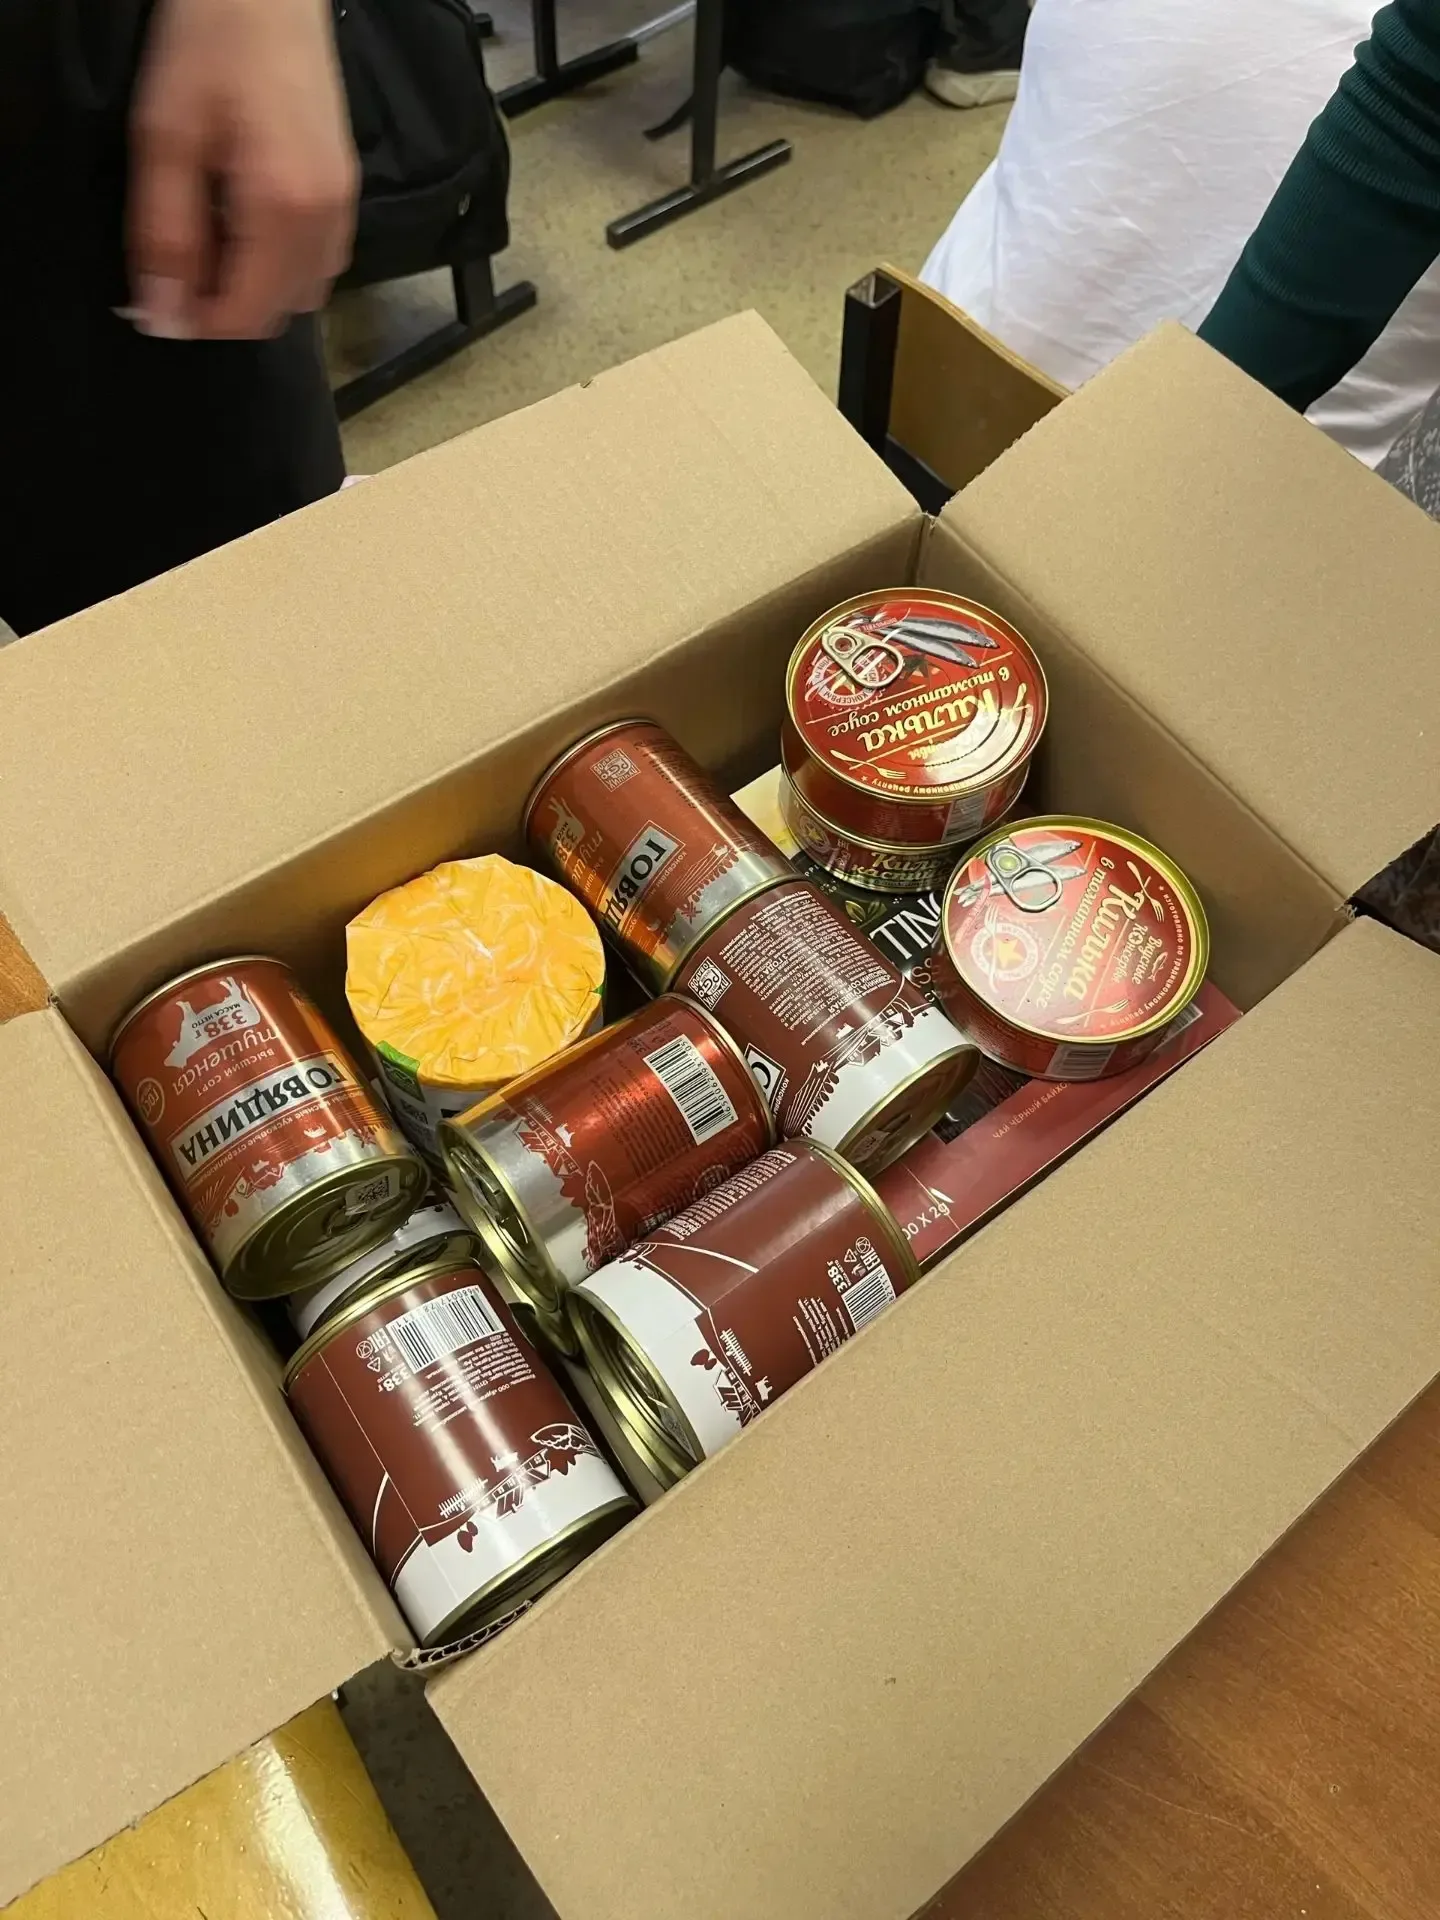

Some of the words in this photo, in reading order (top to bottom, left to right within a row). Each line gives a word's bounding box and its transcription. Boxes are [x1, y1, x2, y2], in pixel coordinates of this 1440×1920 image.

[996, 664, 1012, 682] в
[822, 689, 868, 703] КОНСЕРВЫ
[881, 669, 995, 716] томатном
[826, 710, 880, 737] соусе
[856, 687, 999, 751] Килька
[869, 777, 912, 794] рецепту
[569, 830, 605, 884] туше
[1097, 854, 1116, 870] в
[597, 837, 667, 932] ГОВЯД
[1054, 866, 1110, 962] томатном
[1161, 893, 1183, 942] изготовлено
[1062, 883, 1142, 1002] Килька
[1174, 943, 1186, 956] по
[688, 959, 714, 992] ТОВАРОВ
[1129, 934, 1163, 986] Вкусные
[702, 977, 729, 1007] ЛУЧШИХ
[1033, 961, 1065, 1011] соусе
[1141, 956, 1182, 1011] традиционному
[189, 1013, 214, 1030] НЕТТО
[201, 1007, 248, 1040] 338
[212, 999, 241, 1019] МАССА
[170, 1027, 278, 1095] тушеная
[704, 1074, 732, 1114] 650062
[991, 1122, 1011, 1141] ЧАЙ
[1039, 1076, 1073, 1105] БАЙХО
[177, 1060, 347, 1165] ГОВЯДИНА
[245, 1115, 293, 1147] кусковые
[927, 1200, 951, 1219] 2g
[825, 1263, 849, 1293] 338
[380, 1365, 413, 1392] 338
[496, 1381, 511, 1393] ООО
